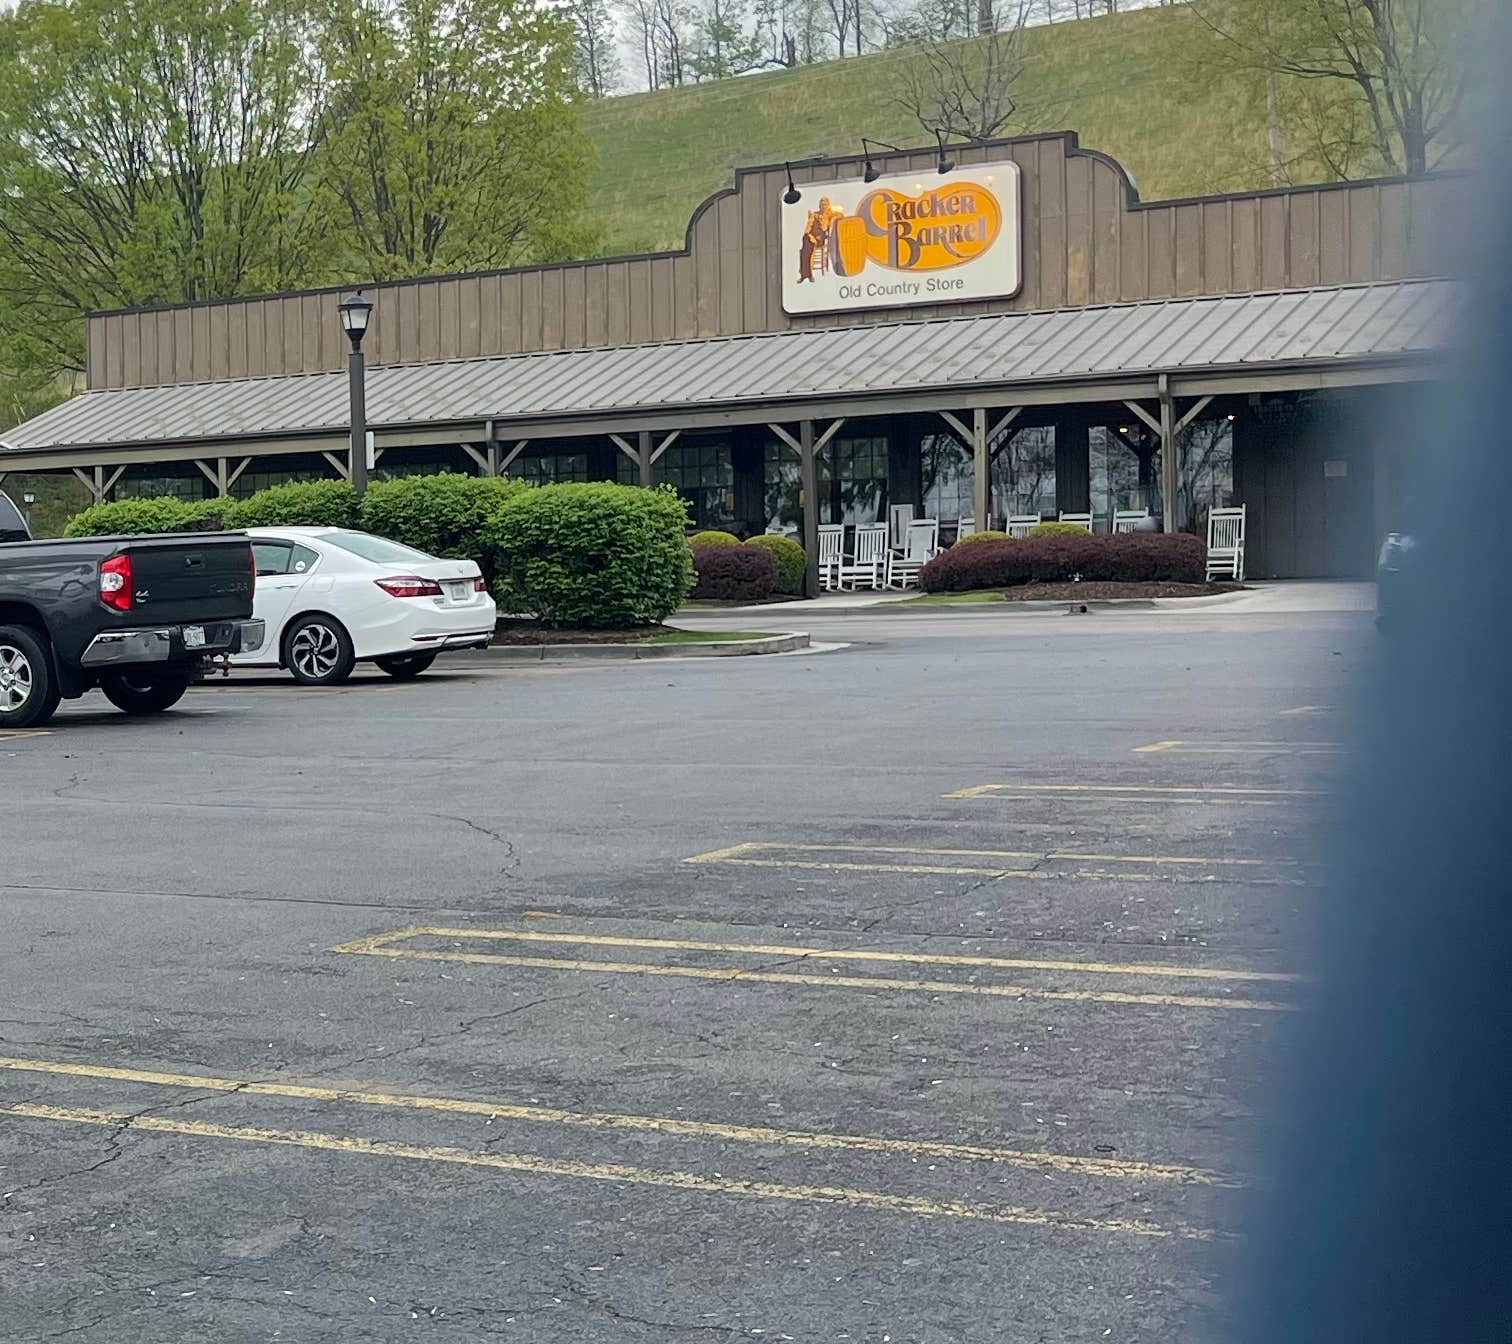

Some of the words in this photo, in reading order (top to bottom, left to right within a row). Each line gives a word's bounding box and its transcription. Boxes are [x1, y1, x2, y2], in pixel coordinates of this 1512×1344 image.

[861, 192, 976, 235] Cracker
[888, 216, 987, 268] Barrel
[839, 285, 861, 298] Old
[866, 281, 920, 297] Country
[926, 278, 965, 292] Store
